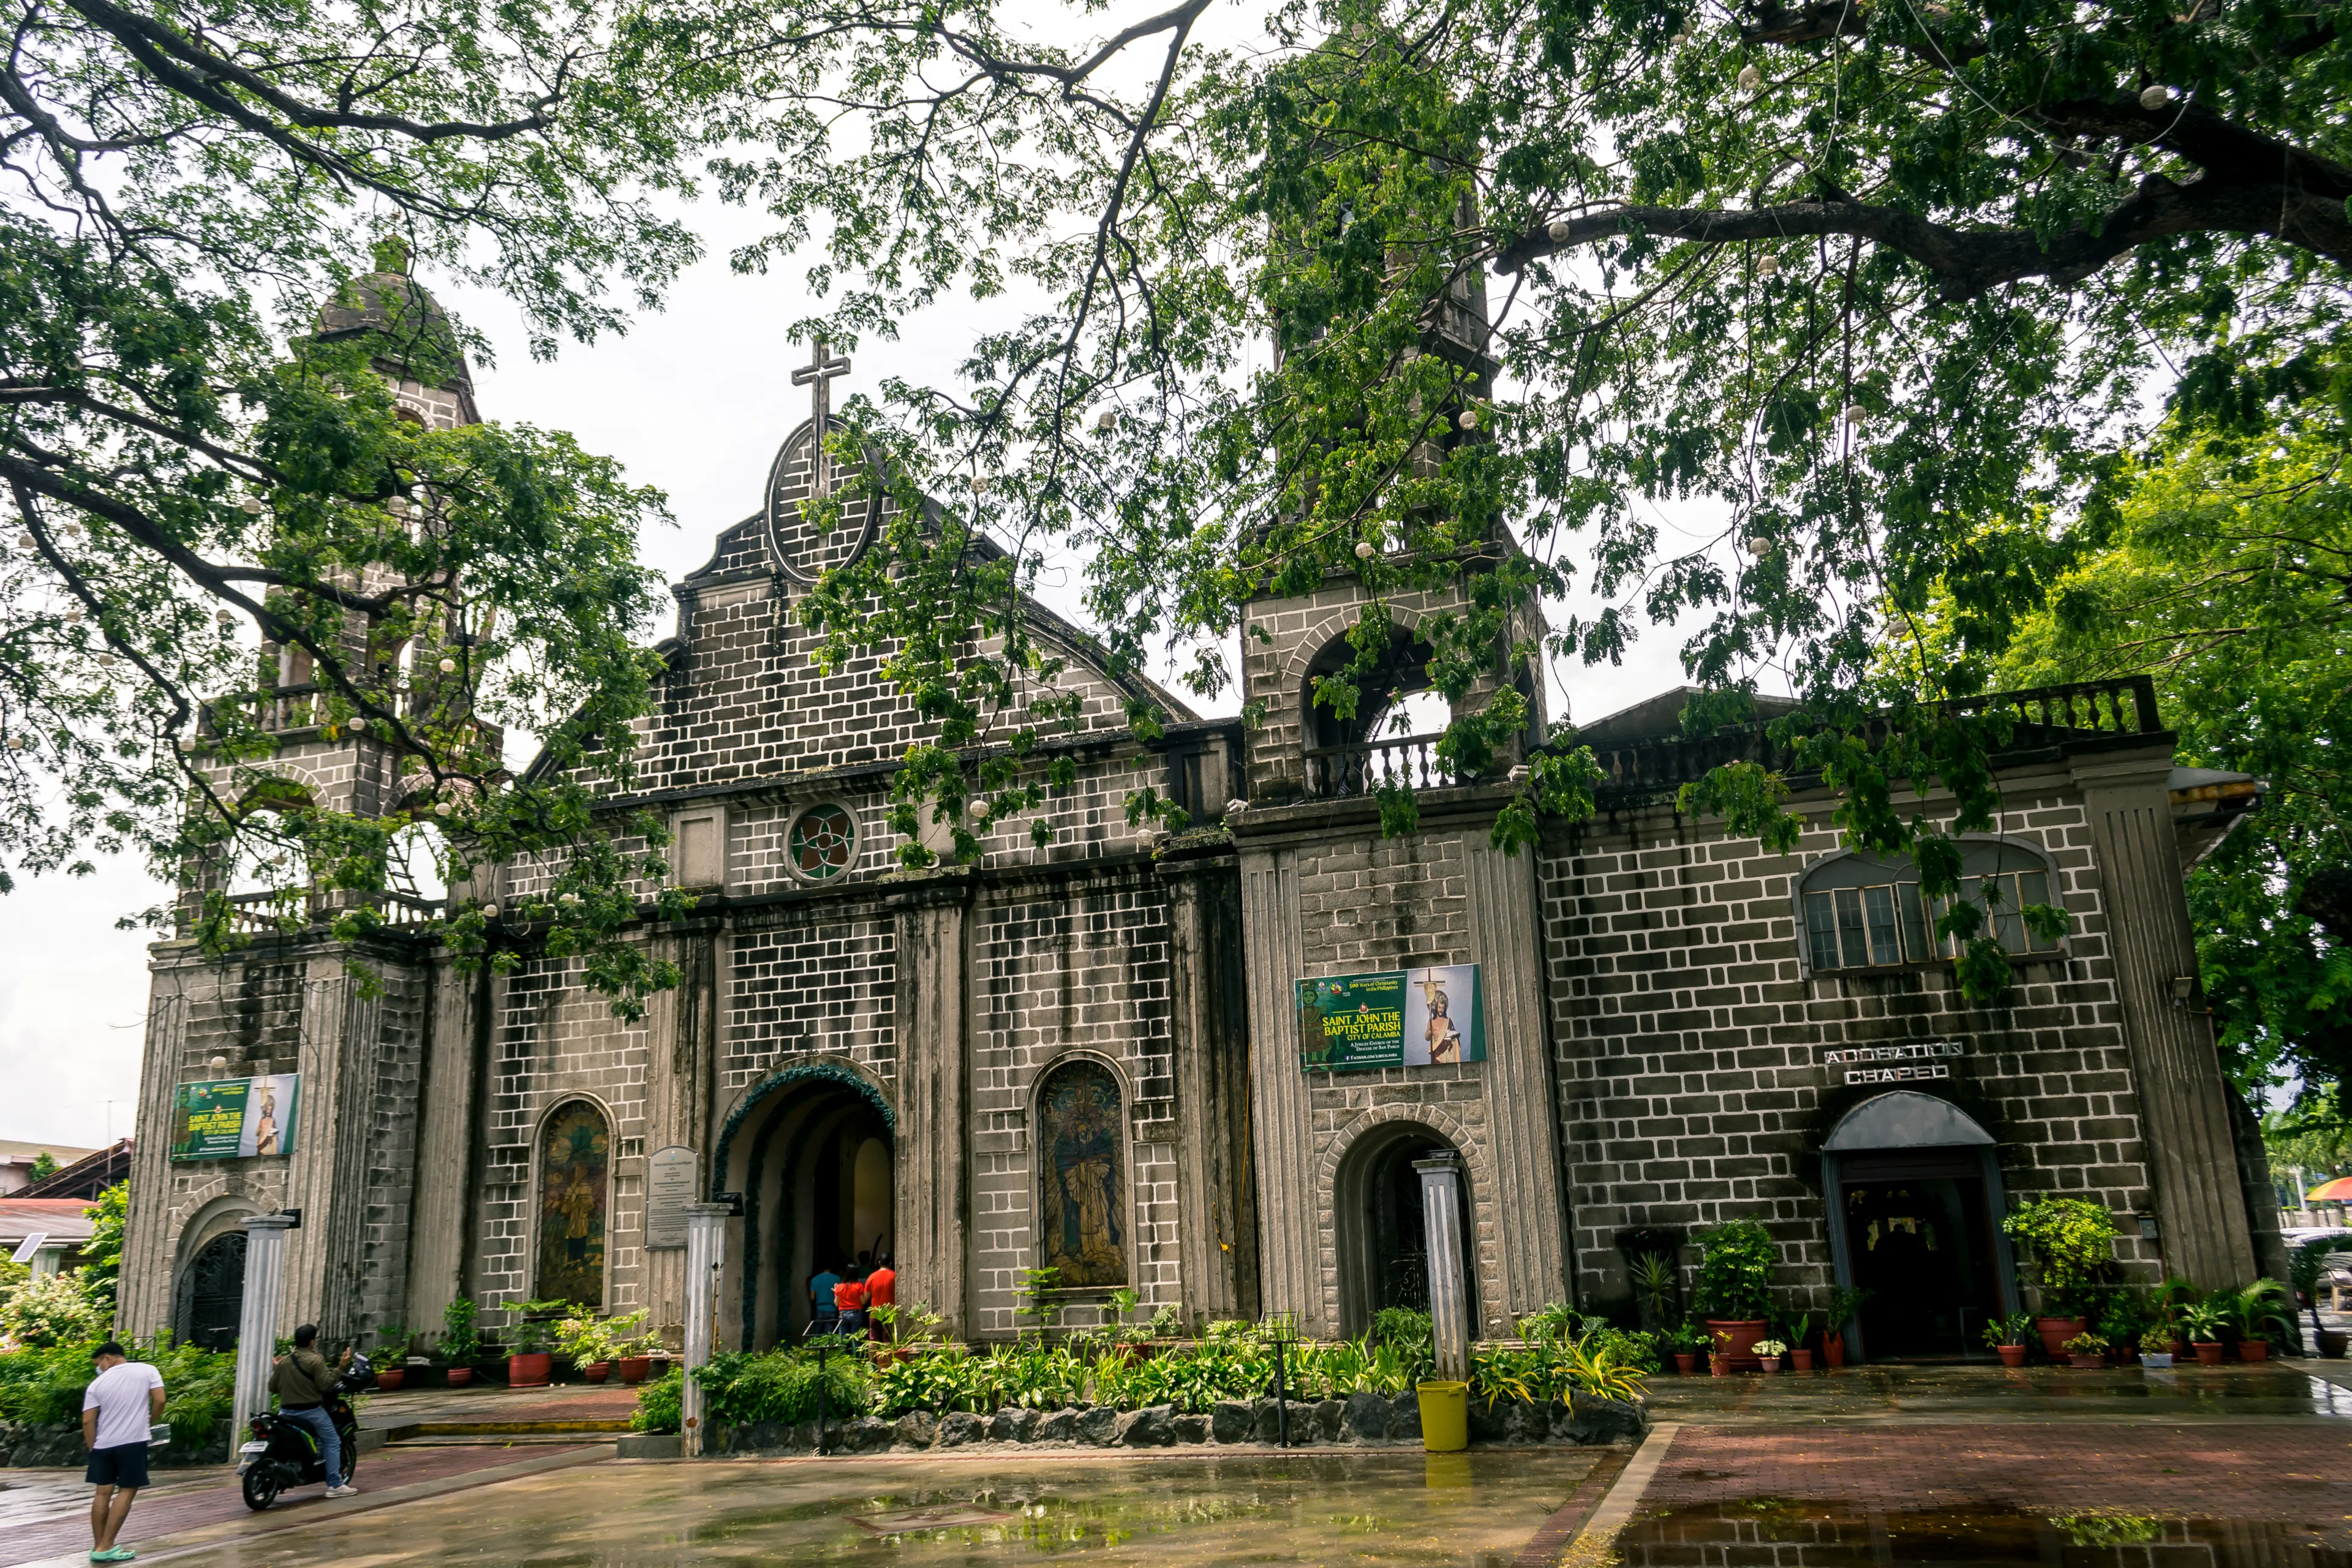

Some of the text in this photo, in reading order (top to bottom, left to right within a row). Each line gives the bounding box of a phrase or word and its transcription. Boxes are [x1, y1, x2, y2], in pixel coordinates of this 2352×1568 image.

[1322, 1012, 1400, 1027] SAINT JOHN THE
[1324, 1022, 1401, 1036] BAPTIST PARISH
[1826, 1042, 1962, 1064] ADORATION
[1845, 1065, 1949, 1085] CHAPEL
